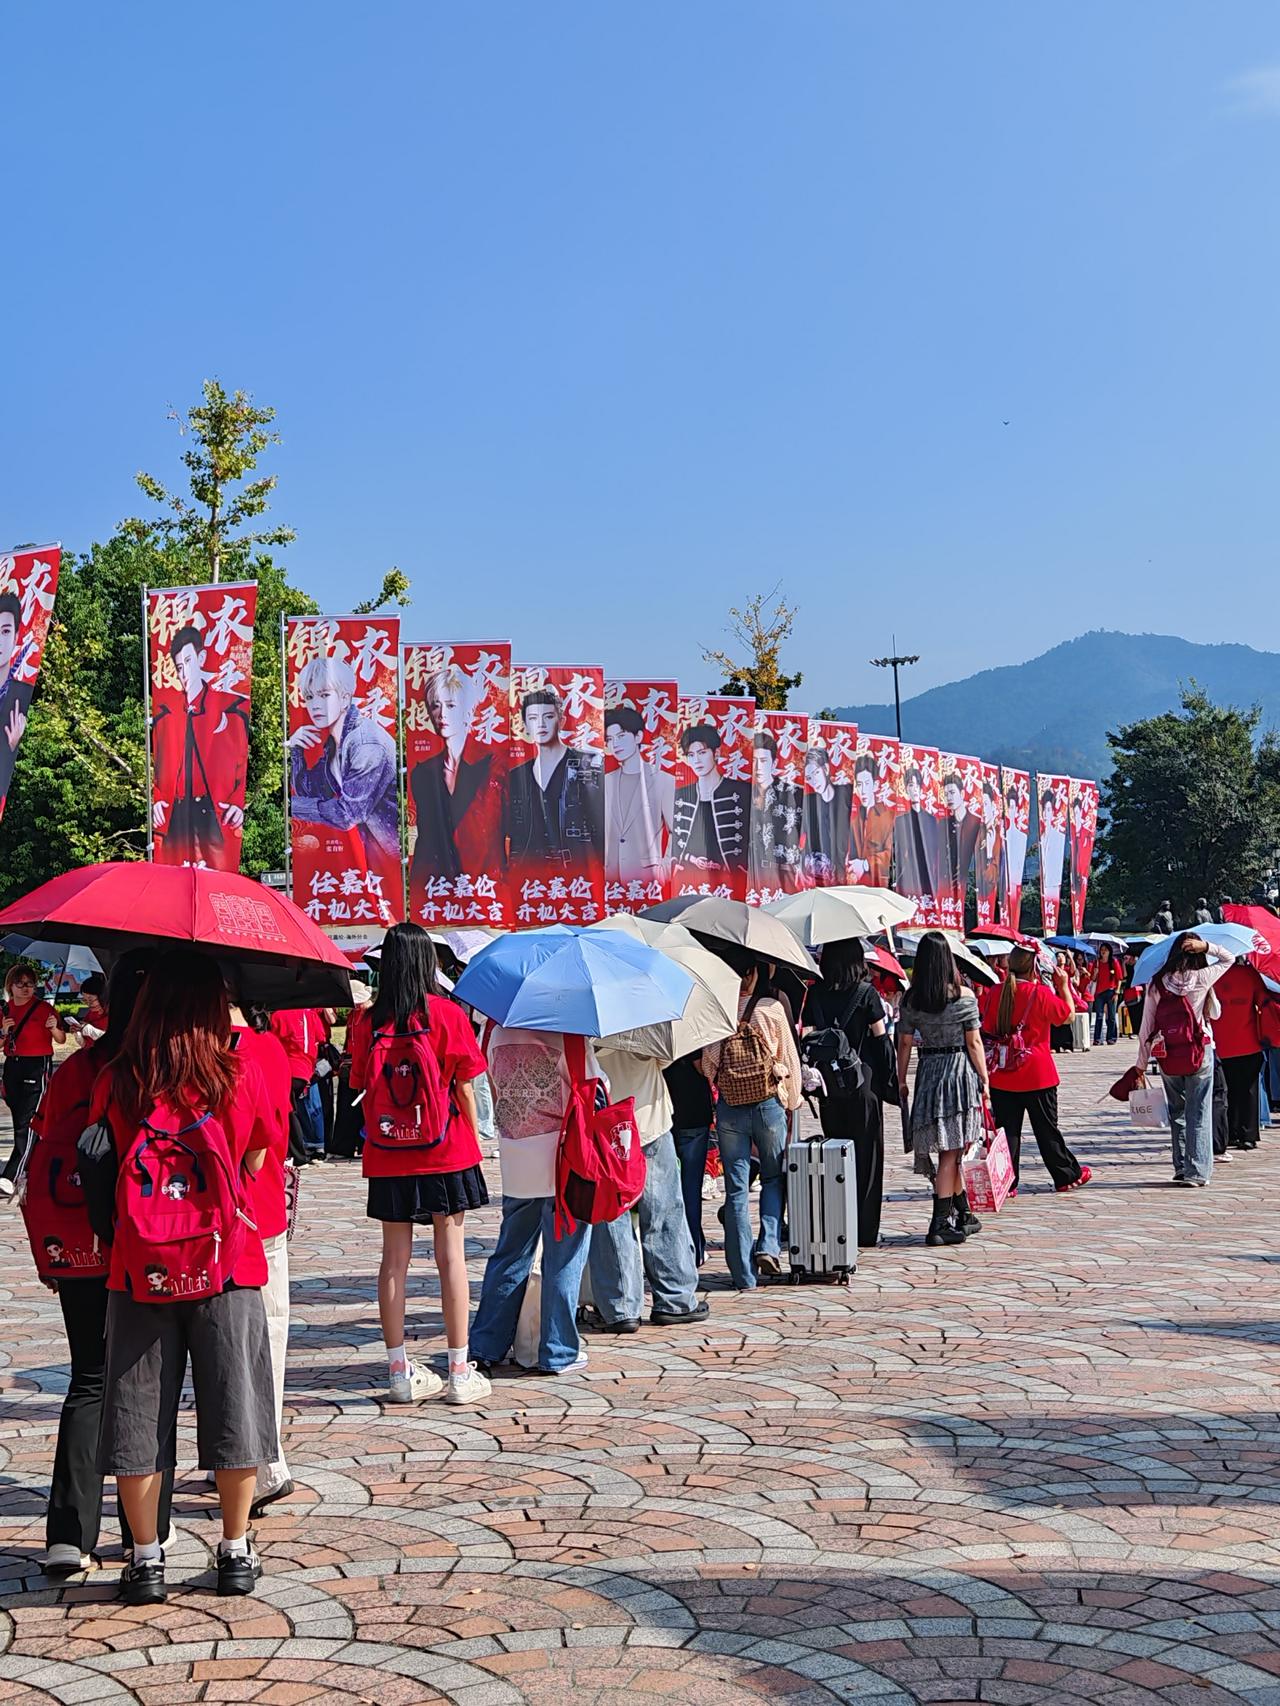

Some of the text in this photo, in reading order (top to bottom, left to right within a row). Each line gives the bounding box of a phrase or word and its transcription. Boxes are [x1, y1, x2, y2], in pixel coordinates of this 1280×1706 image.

[150, 591, 255, 655] 锦衣
[288, 619, 398, 682] 锦衣
[404, 645, 510, 702] 锦衣
[510, 666, 604, 719] 锦衣
[424, 873, 498, 900] 任嘉伦
[520, 875, 594, 901] 任嘉伦
[604, 879, 663, 901] 任嘉伦
[419, 900, 505, 922] 开机大吉
[516, 902, 600, 922] 开机大吉
